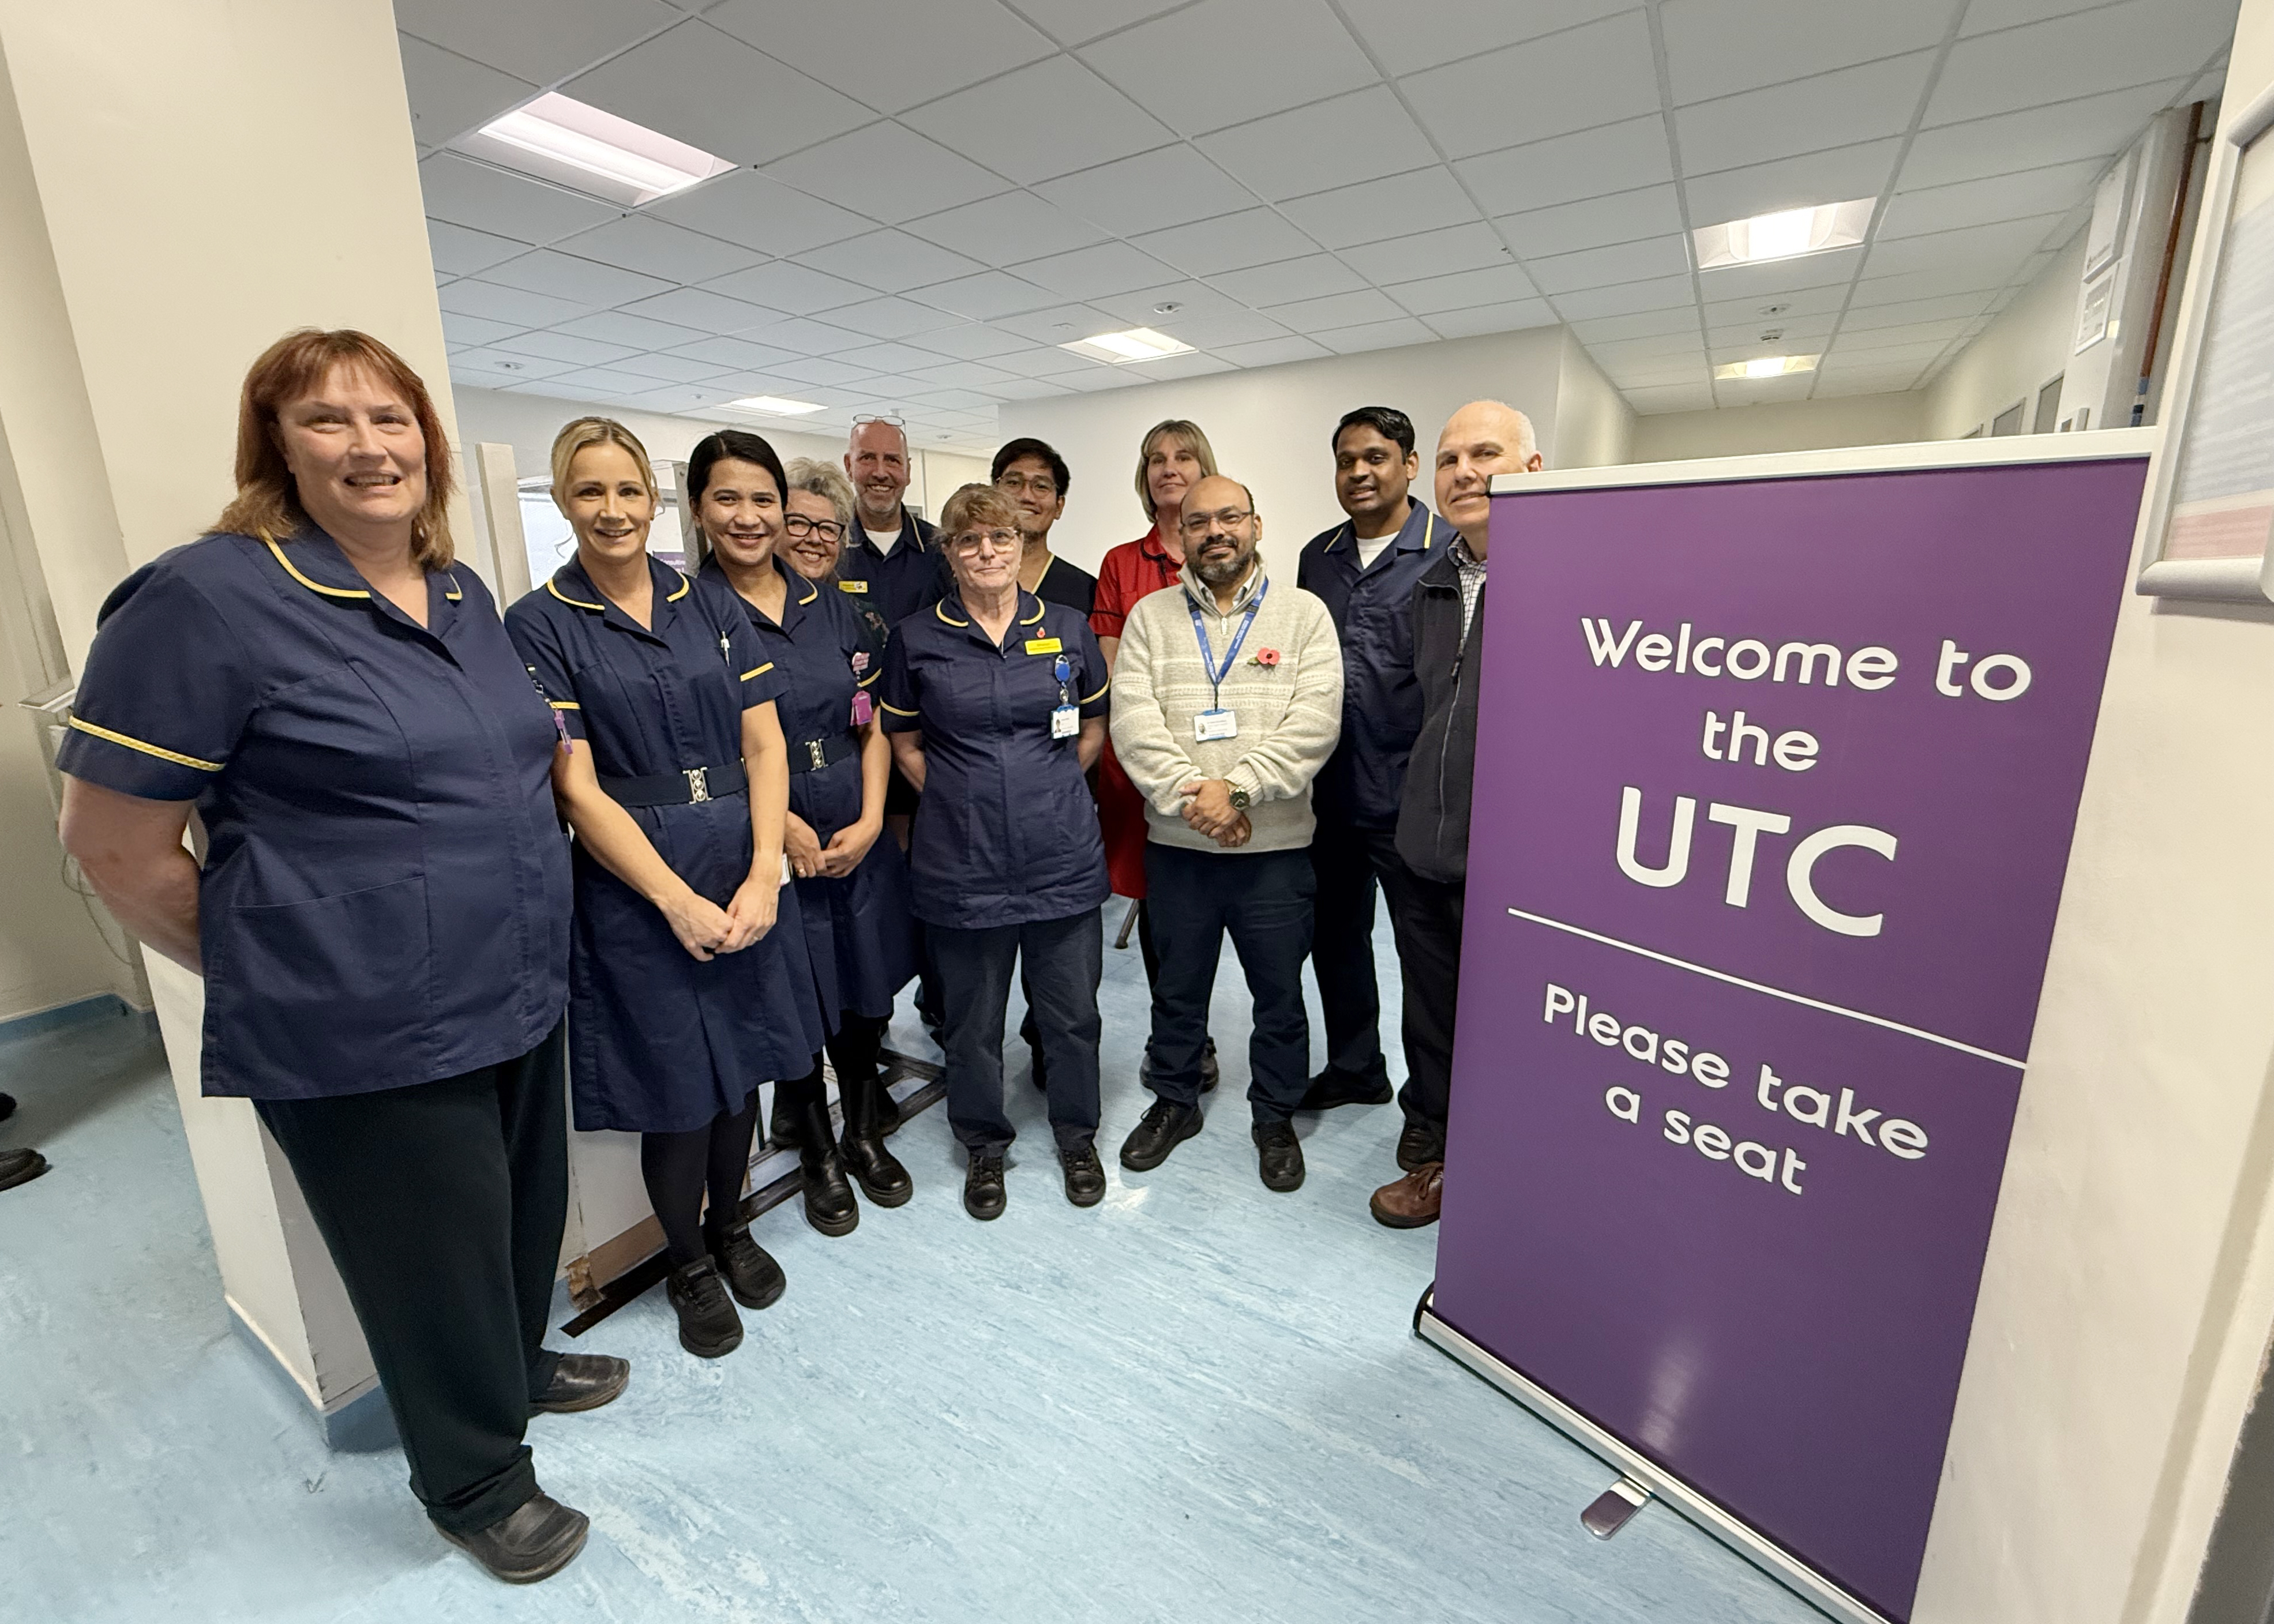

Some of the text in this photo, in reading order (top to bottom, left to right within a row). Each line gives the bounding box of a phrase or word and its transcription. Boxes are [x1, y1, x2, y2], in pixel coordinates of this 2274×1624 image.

[1581, 617, 2032, 701] Welcome to
[1702, 710, 1819, 772] the
[1616, 785, 1898, 937] UTC
[1544, 983, 1928, 1160] Please take
[1605, 1086, 1807, 1196] a seat
